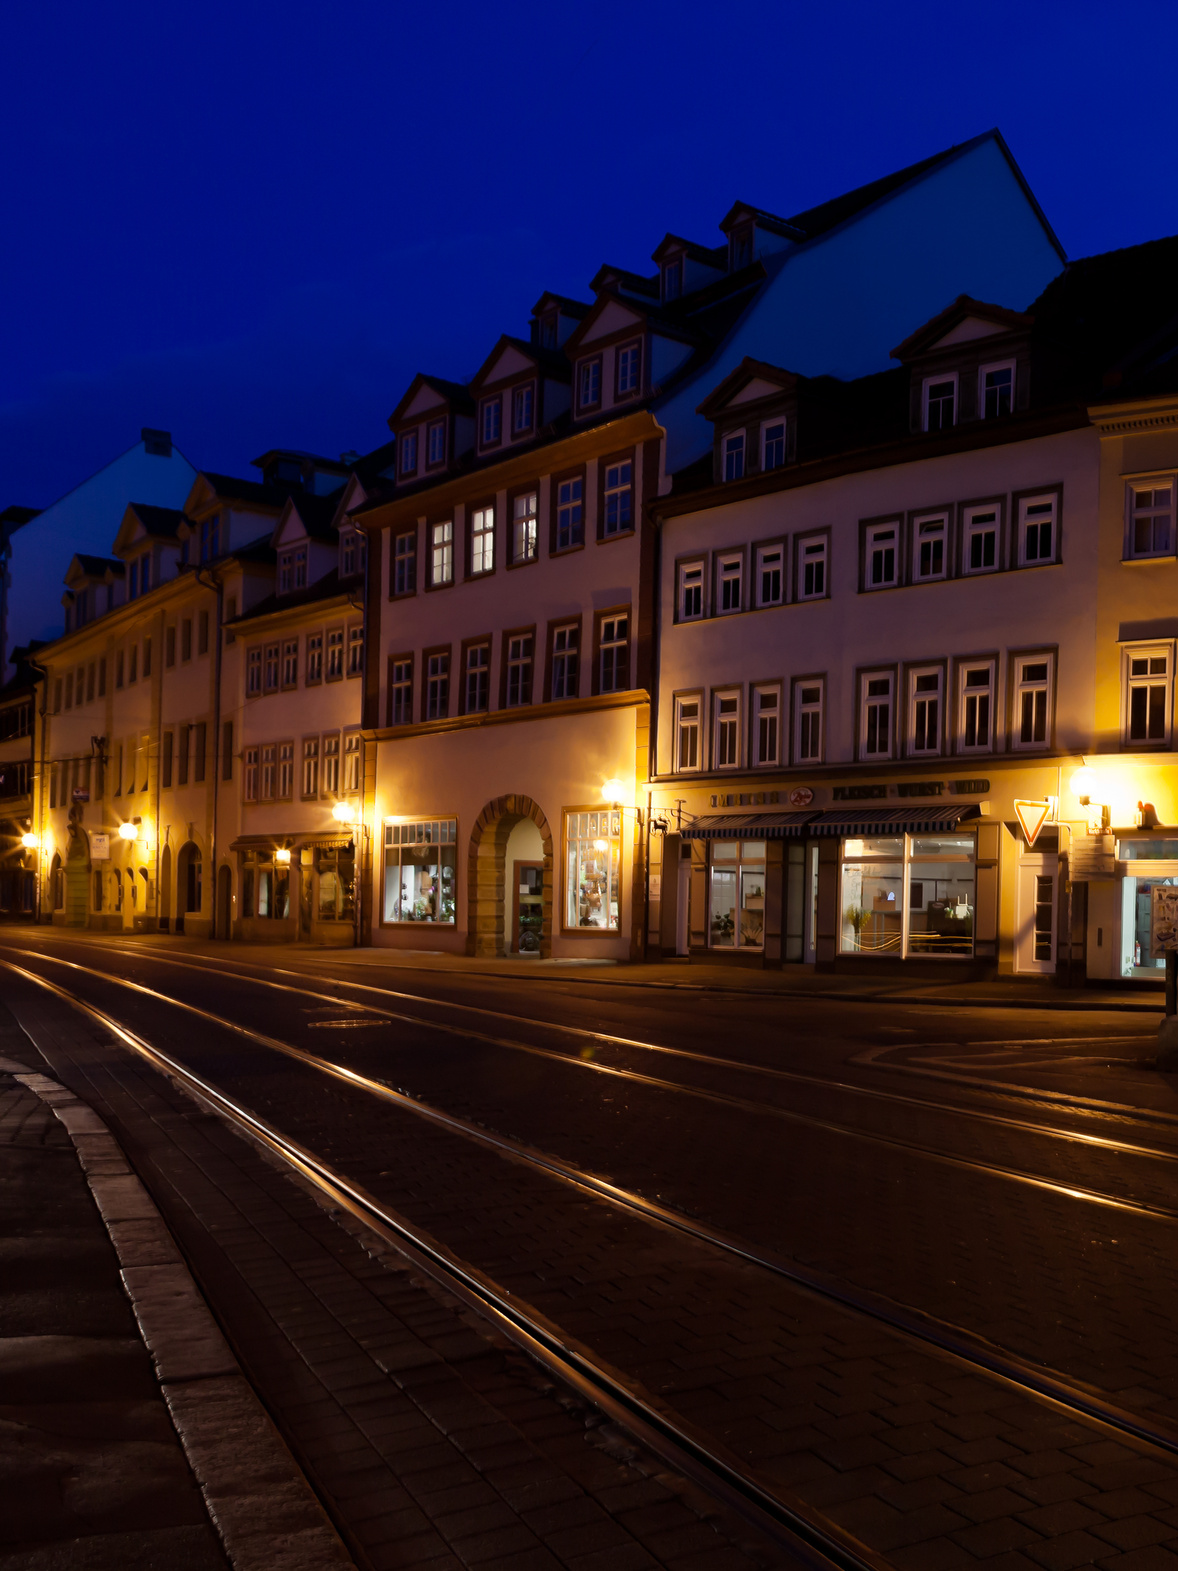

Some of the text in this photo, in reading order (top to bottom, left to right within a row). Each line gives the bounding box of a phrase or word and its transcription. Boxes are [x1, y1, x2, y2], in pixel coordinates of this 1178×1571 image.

[832, 779, 991, 800] FLEISCH WURST WILD
